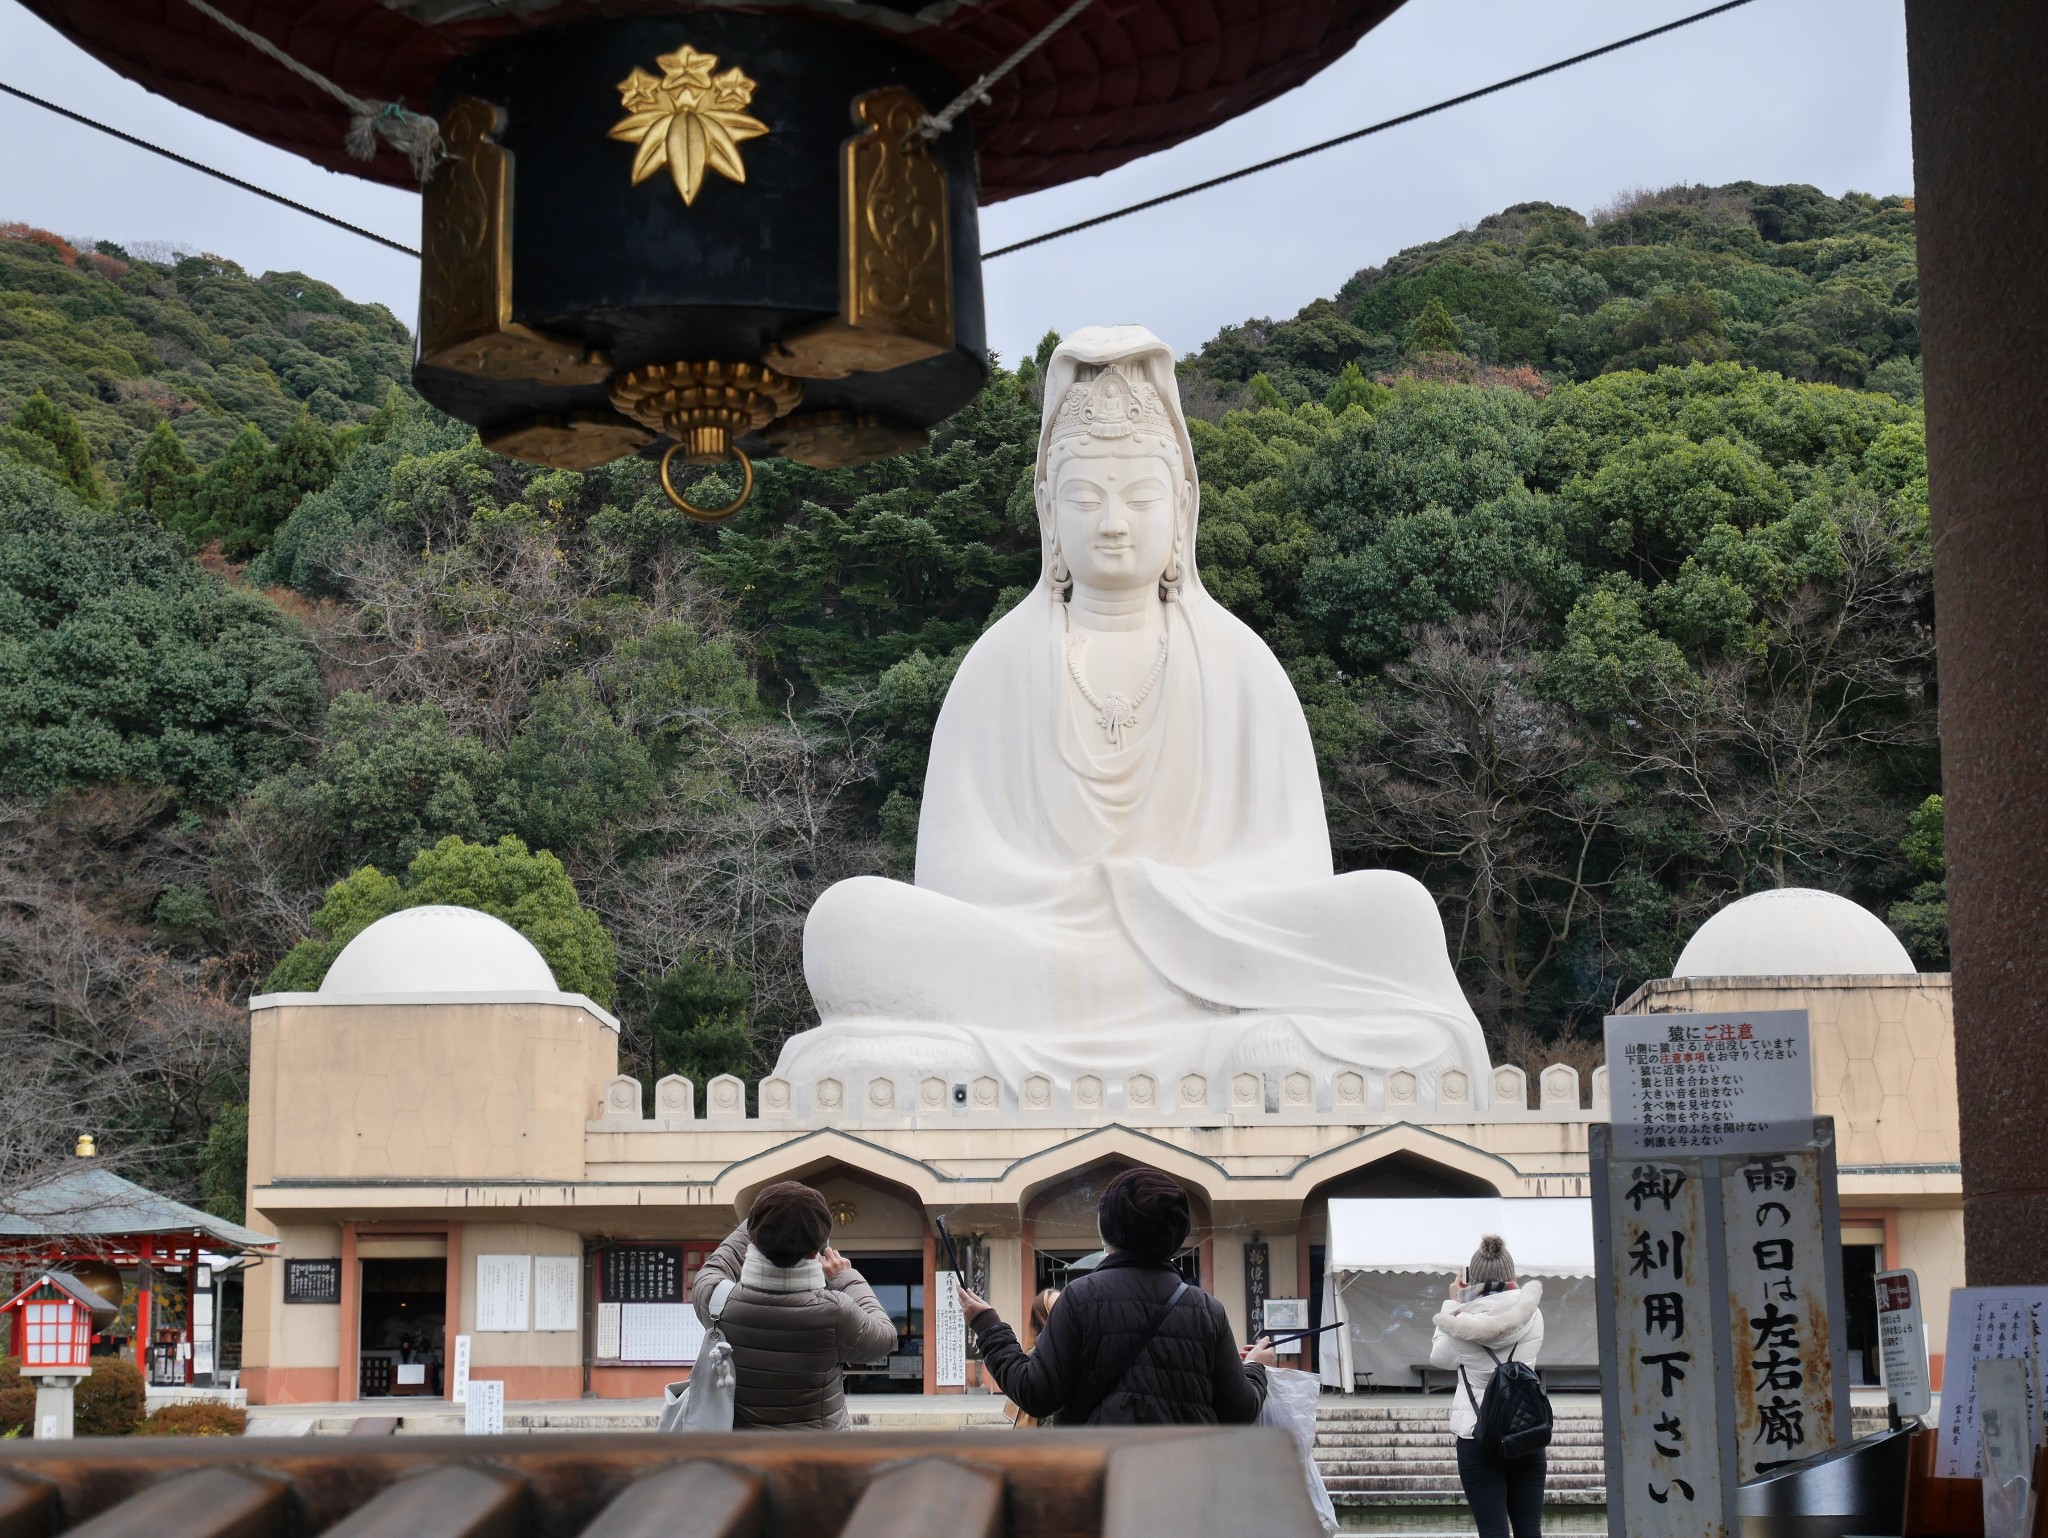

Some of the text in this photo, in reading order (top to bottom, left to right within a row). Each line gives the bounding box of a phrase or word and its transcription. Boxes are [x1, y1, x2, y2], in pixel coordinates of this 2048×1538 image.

[1668, 1023, 1754, 1041] 猿にご注意
[1625, 1050, 1797, 1065] 下記の注意事項をお守りください
[1625, 1164, 1694, 1503] 御利用下さい
